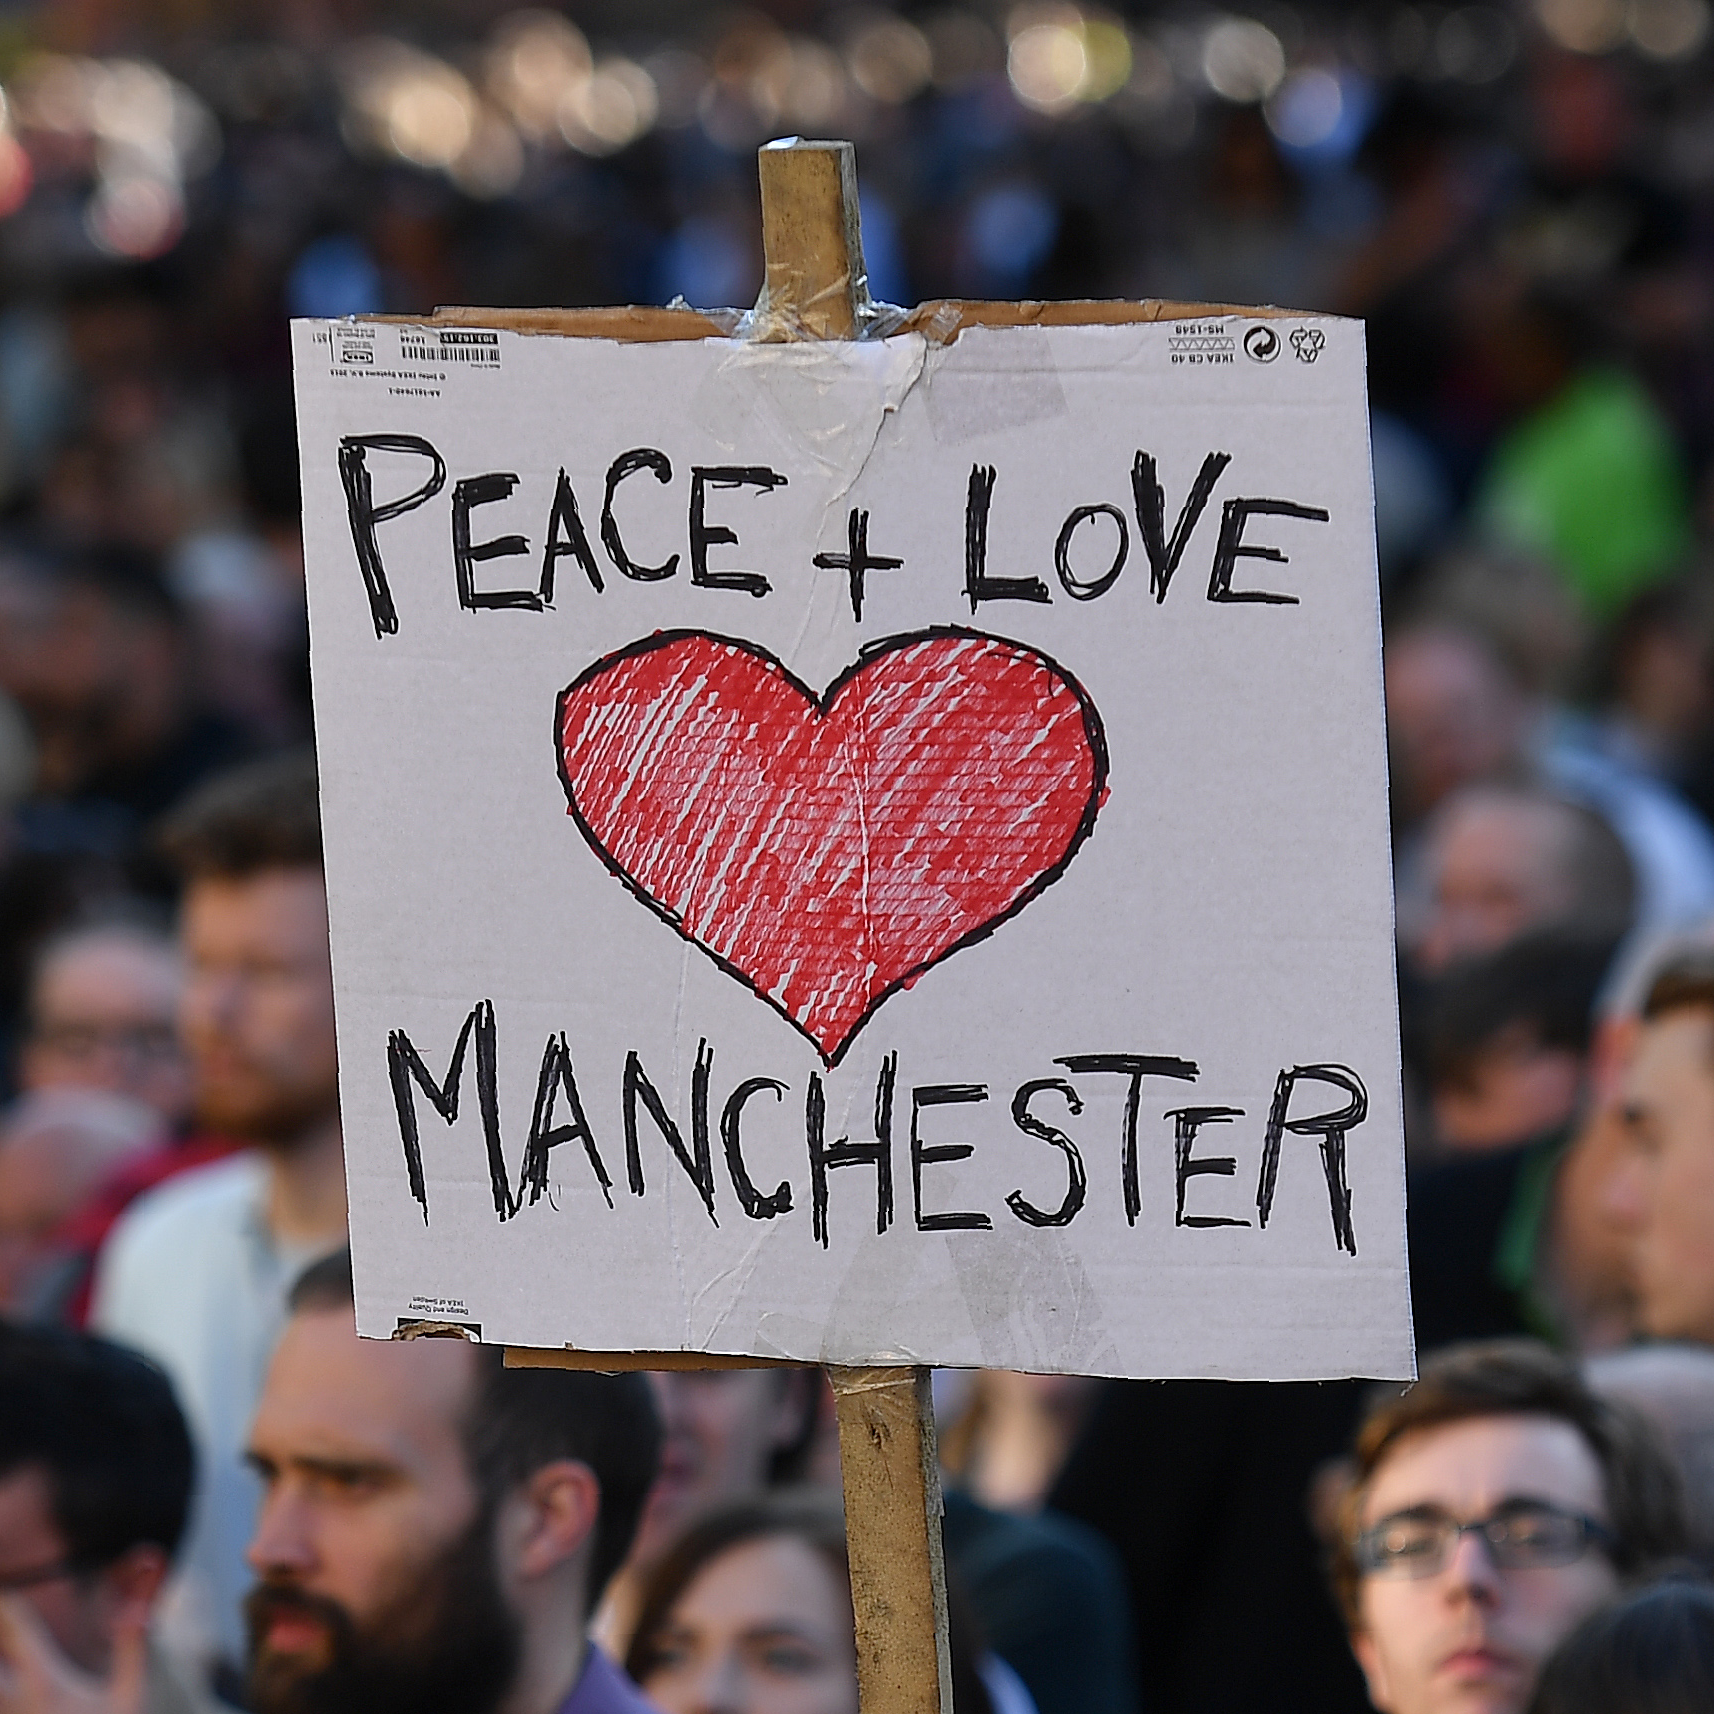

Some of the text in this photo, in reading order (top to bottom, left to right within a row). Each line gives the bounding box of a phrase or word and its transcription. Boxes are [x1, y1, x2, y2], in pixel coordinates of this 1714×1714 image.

[1171, 353, 1234, 363] IKEA CB 40
[398, 371, 416, 379] IKEA
[337, 432, 1331, 639] PEACE + LOVE
[385, 998, 1369, 1258] MANCHESTER
[408, 1303, 432, 1313] Quality
[446, 1307, 469, 1315] Design
